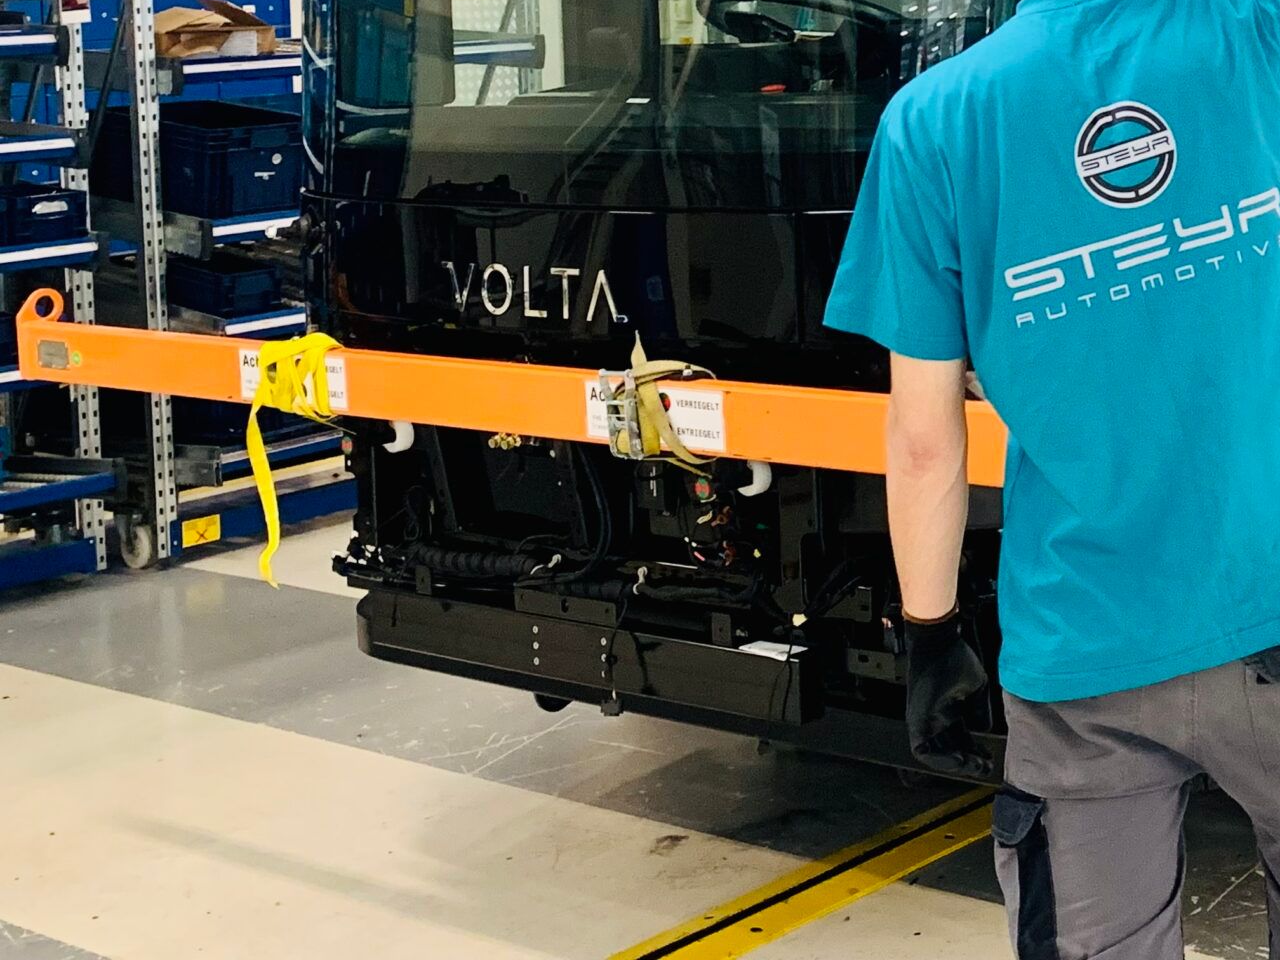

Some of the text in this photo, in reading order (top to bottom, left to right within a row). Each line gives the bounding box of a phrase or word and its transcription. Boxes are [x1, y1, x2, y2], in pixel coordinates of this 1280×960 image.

[1081, 136, 1170, 172] STEYR
[441, 261, 622, 323] VOLTA
[676, 399, 719, 411] VERRIEGELT
[677, 427, 720, 440] ENTRIEGELT
